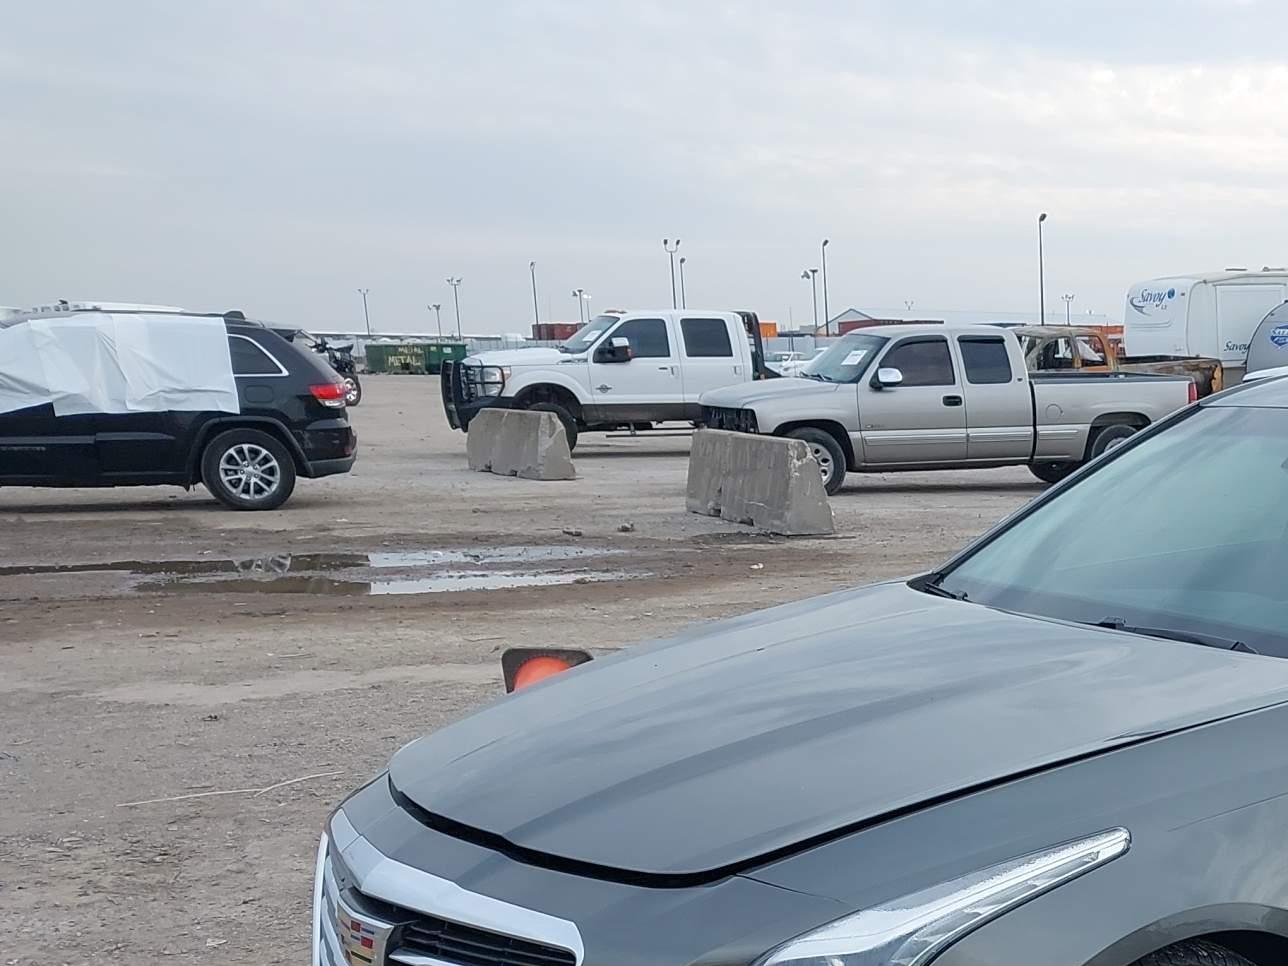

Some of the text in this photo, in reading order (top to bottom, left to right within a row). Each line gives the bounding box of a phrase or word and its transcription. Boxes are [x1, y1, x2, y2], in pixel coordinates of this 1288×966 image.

[1140, 289, 1166, 308] Savoy
[1224, 341, 1249, 354] Savoy
[388, 355, 421, 366] METAL
